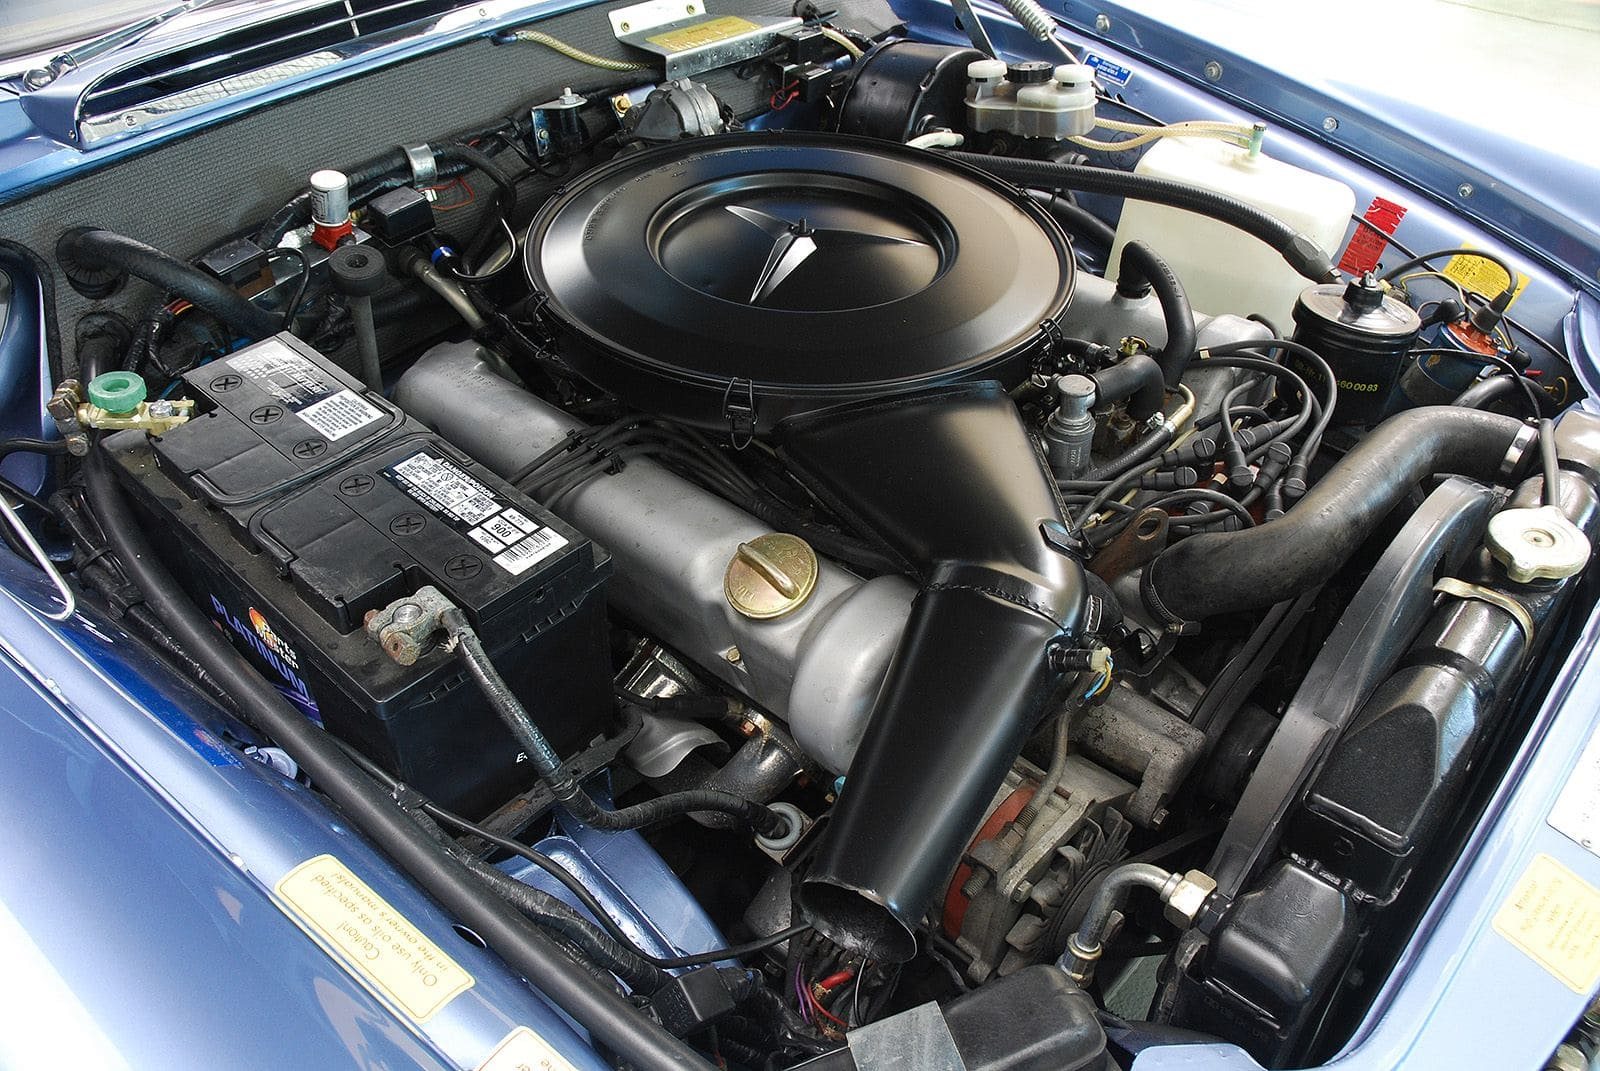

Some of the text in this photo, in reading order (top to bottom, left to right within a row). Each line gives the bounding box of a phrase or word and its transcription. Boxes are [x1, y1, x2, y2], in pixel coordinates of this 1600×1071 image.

[490, 522, 512, 539] 900
[209, 592, 311, 700] PLATINUM
[255, 625, 299, 671] Master
[262, 622, 298, 661] Parts
[310, 872, 438, 988] Only use oils as specified
[329, 871, 449, 974] in the owner's manuals!
[335, 919, 381, 962] Caution!
